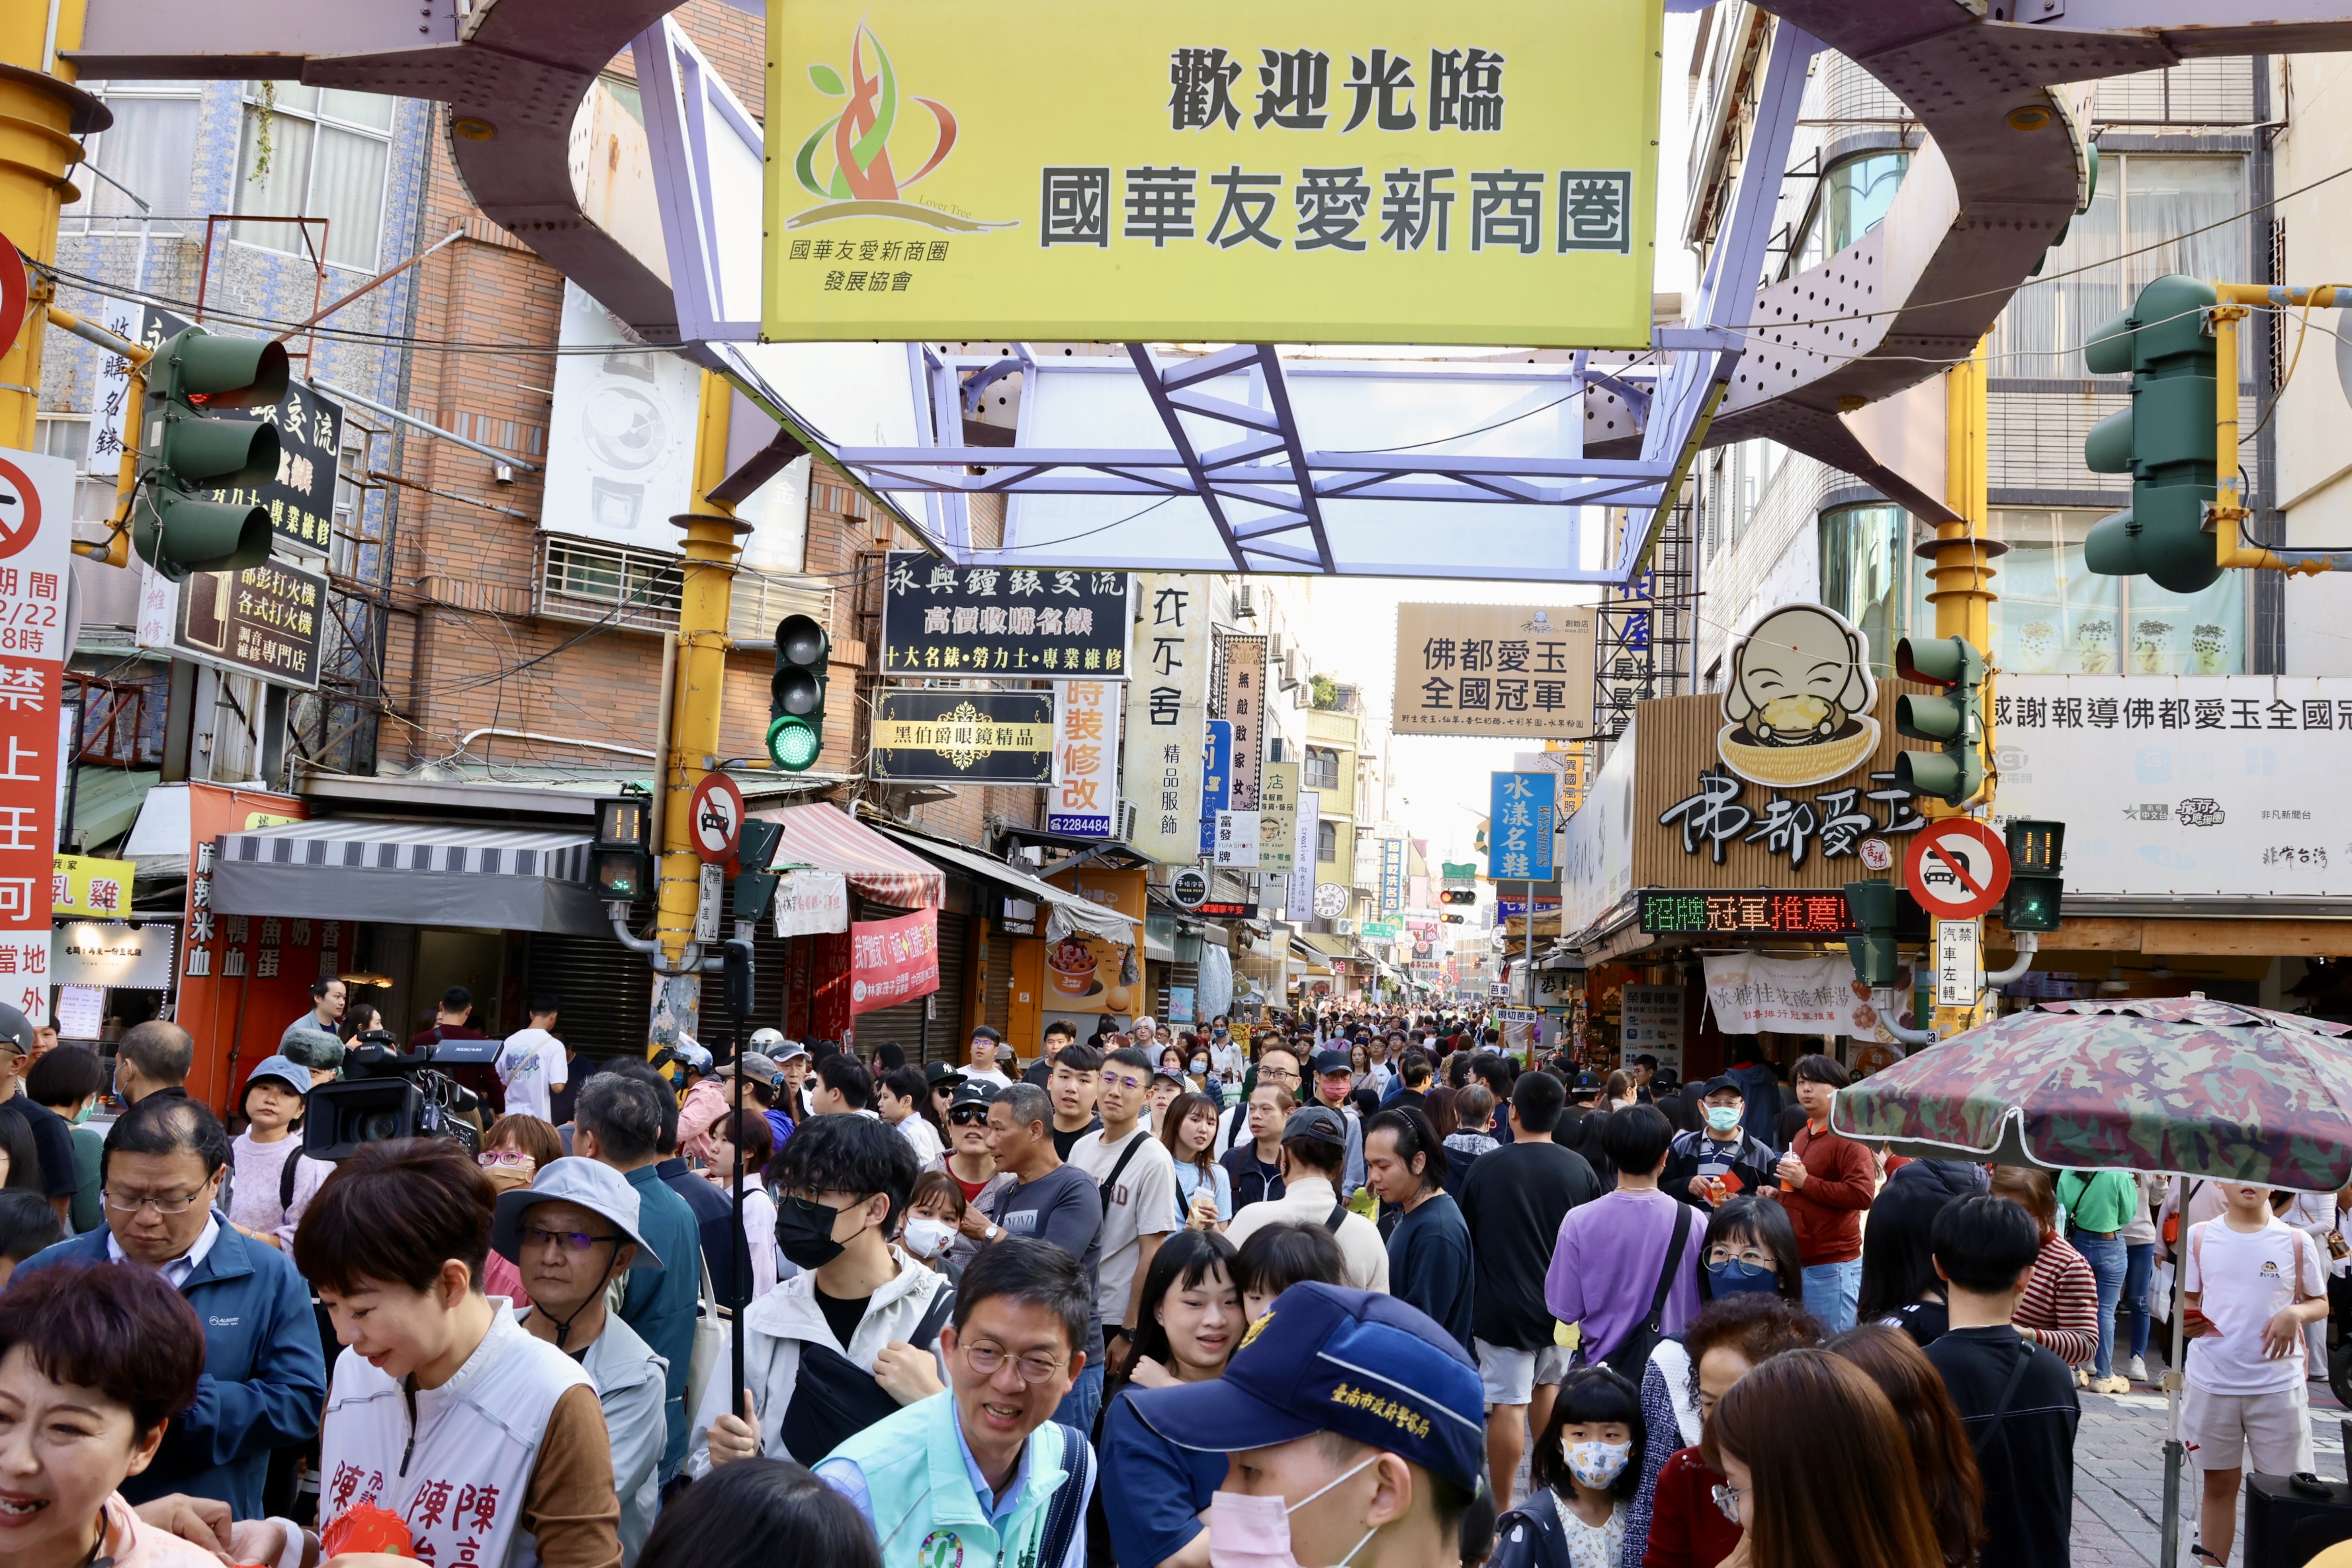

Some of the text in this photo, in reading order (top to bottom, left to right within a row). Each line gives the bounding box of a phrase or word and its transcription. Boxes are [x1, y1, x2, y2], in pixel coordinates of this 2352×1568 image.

[1168, 48, 1504, 133] 歡迎光臨
[919, 195, 972, 219] Lover Tree
[1042, 167, 1632, 255] 國華友愛新商圈
[789, 240, 949, 262] 國華友愛新商圈
[824, 270, 913, 292] 發展協會
[238, 590, 312, 636] 各式打火機
[924, 606, 1093, 636] 高價收購名錶
[1566, 619, 1589, 628] 創始店
[263, 638, 306, 673] 專門店
[1151, 574, 1189, 725] 衣不舍
[1423, 637, 1567, 674] 佛都愛玉
[1421, 677, 1566, 713] 全國冠軍
[894, 726, 1033, 746] 黑伯爵眼鏡精品
[1063, 681, 1104, 810] 時裝修改
[1161, 744, 1180, 835] 精品服飾
[616, 809, 639, 838] 11
[1063, 818, 1109, 832] 2284484
[1501, 775, 1534, 877] 水漾名鞋
[1659, 764, 1927, 871] 佛都愛玉
[2261, 810, 2312, 820] 非凡新聞台
[1865, 842, 1885, 864] 吉祥
[2025, 831, 2051, 865] 11
[1177, 879, 1203, 888] 手指泡芙
[709, 871, 720, 938] 禁止
[319, 921, 341, 976] 香腸
[1942, 927, 1956, 1000] 汽車左轉
[1491, 984, 1509, 996] 芭樂
[1627, 992, 1679, 1004] 榮耀報導
[1714, 982, 1850, 1009] 冰糖桂花酸梅湯
[1498, 1010, 1536, 1022] 現切芭樂
[1743, 1009, 1835, 1022] 銷售排行冠軍推薦
[1331, 1382, 1430, 1439] 臺南市政府警察局
